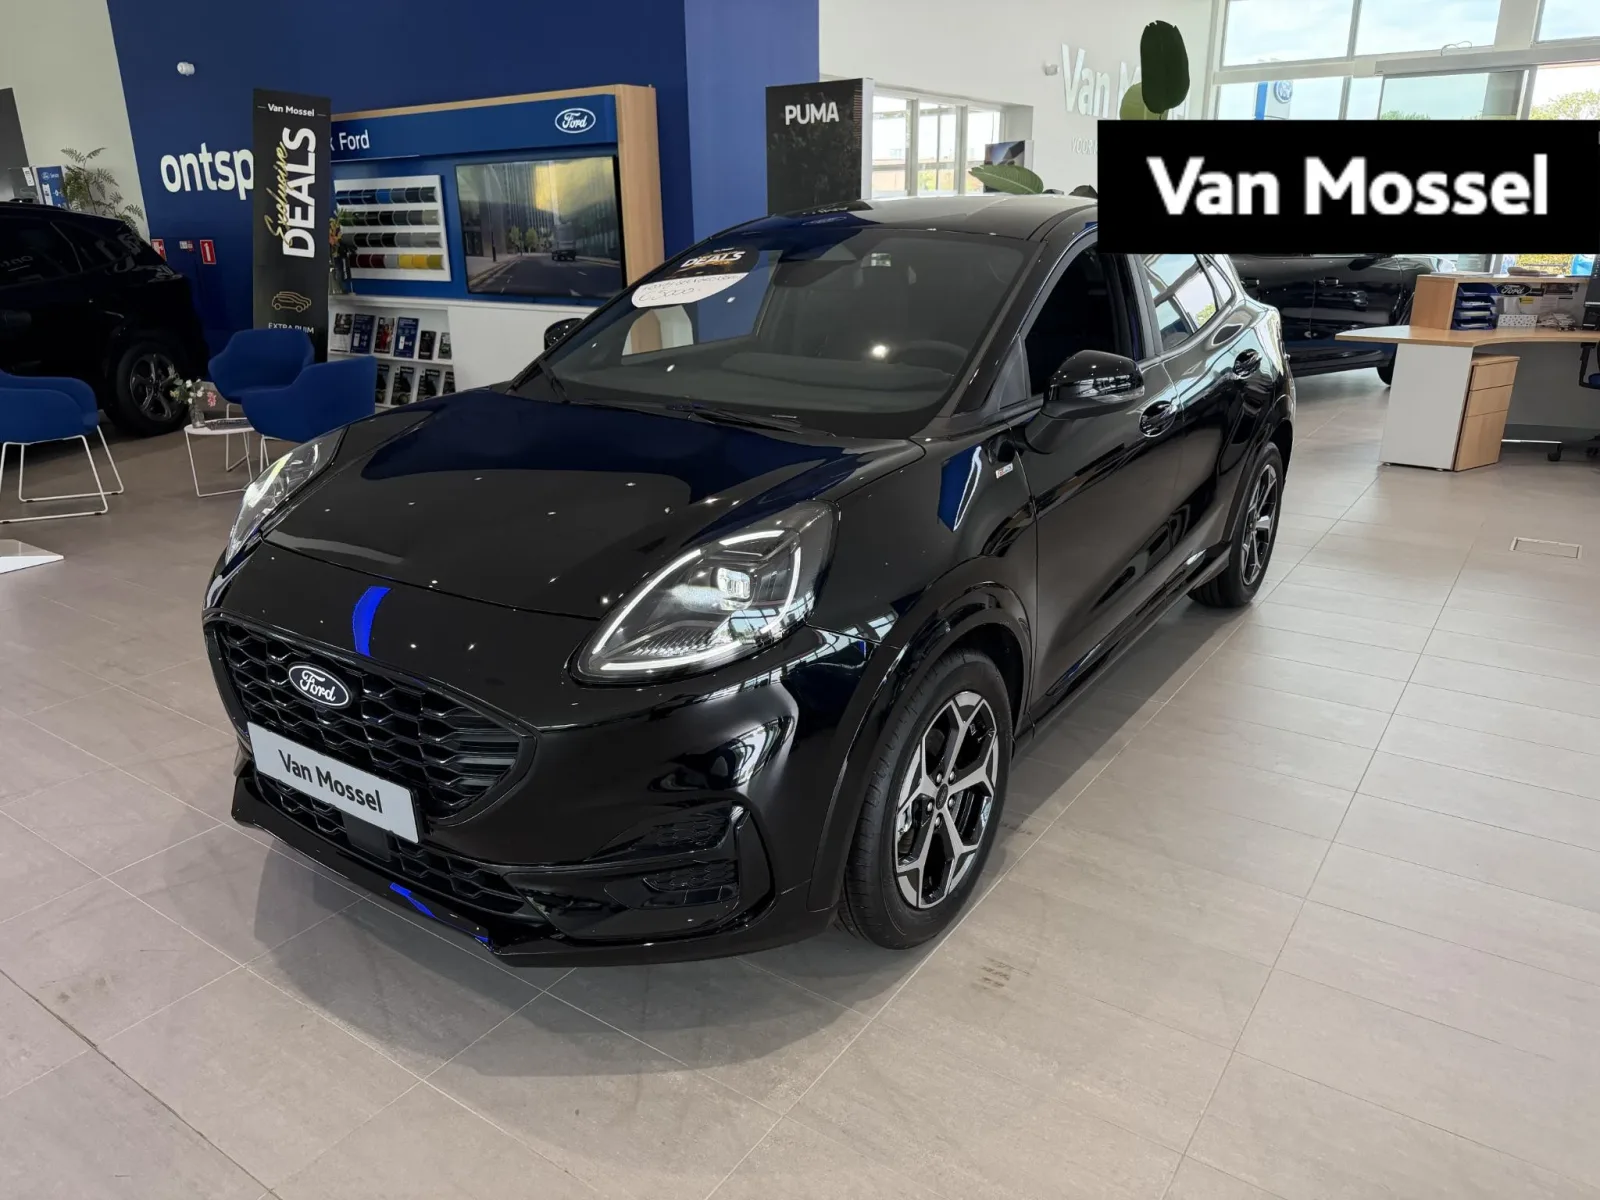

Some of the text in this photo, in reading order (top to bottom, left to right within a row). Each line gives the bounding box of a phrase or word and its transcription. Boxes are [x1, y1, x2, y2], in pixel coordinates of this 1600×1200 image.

[1061, 43, 1110, 119] Van
[267, 103, 315, 117] Van Mossel
[562, 112, 587, 128] Ford
[785, 101, 840, 125] PUMA
[338, 129, 370, 151] Ford
[282, 127, 317, 258] DEALS
[1500, 285, 1525, 295] Ford
[300, 670, 336, 702] Ford
[278, 749, 384, 814] Van Mossel
